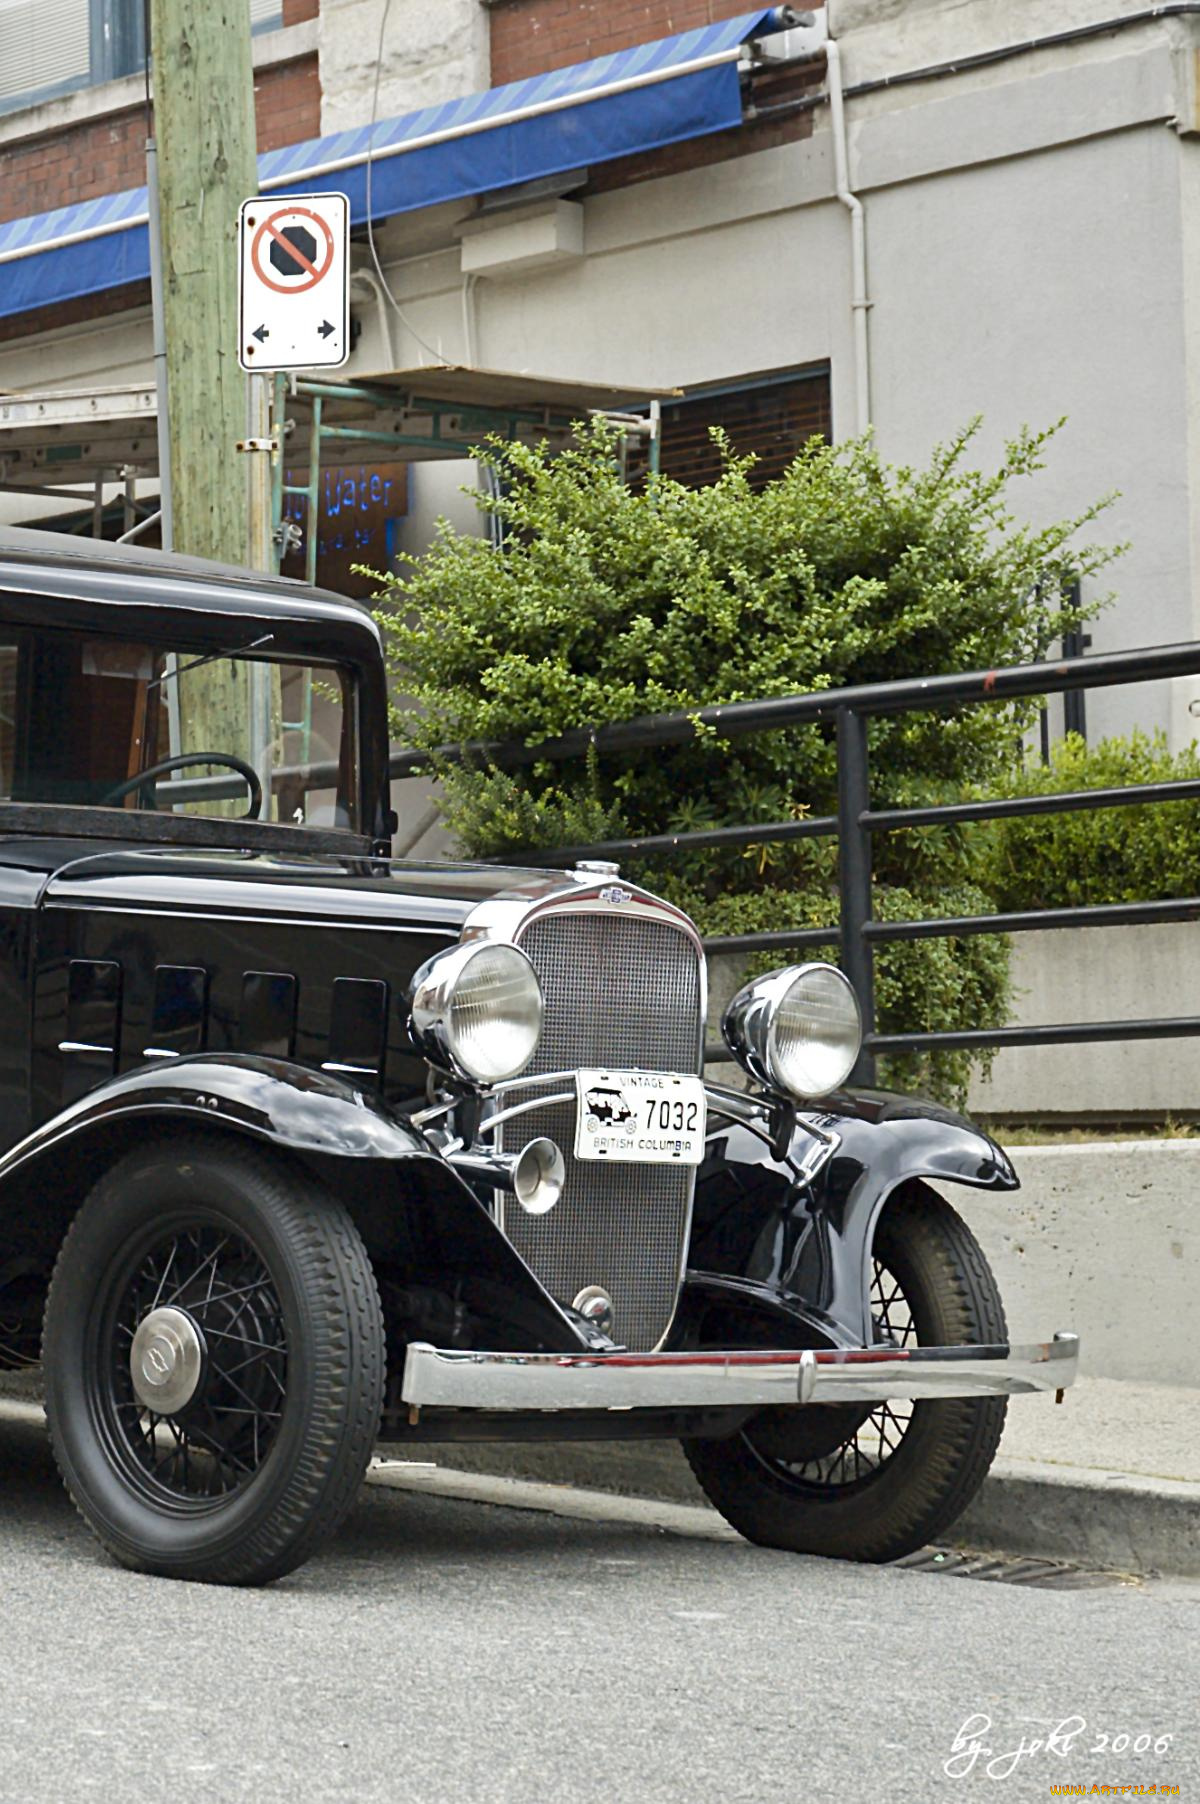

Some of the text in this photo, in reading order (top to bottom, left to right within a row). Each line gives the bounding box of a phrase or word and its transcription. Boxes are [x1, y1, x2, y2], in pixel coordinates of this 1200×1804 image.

[619, 1077, 664, 1089] VINTAGE
[646, 1099, 698, 1132] 7032
[593, 1136, 691, 1151] BRITISH COLUMBIA
